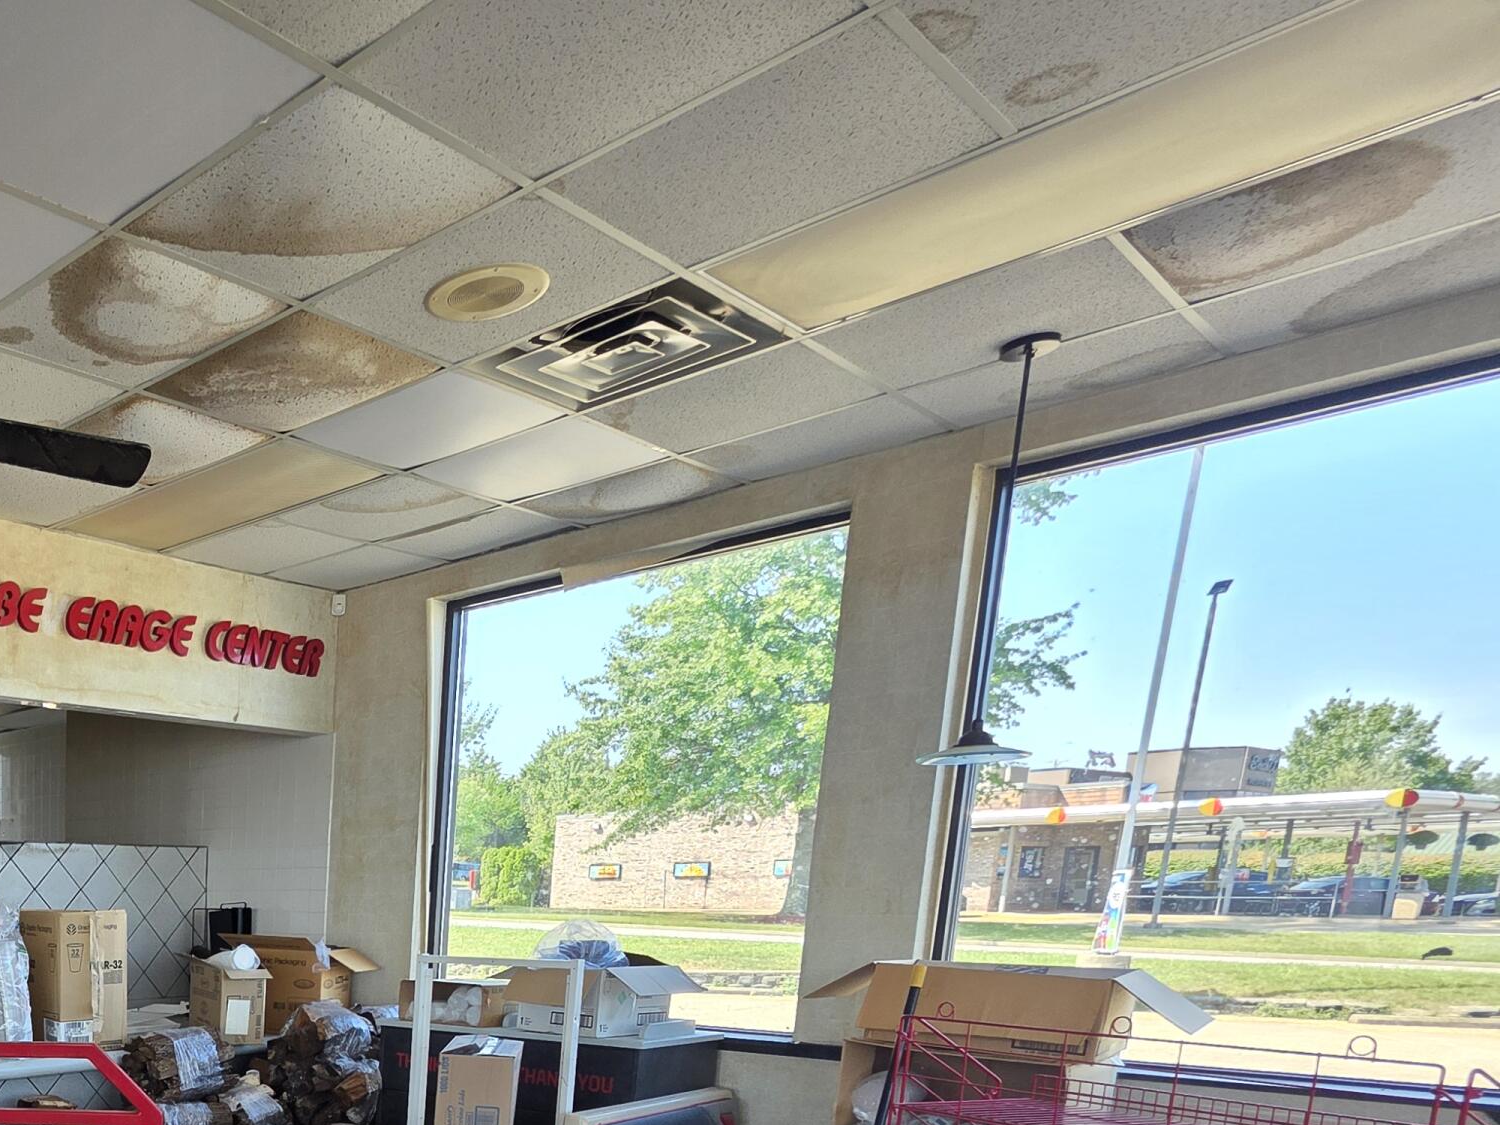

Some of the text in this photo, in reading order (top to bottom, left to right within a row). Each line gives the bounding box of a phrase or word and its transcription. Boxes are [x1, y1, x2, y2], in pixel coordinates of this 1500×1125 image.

[204, 620, 325, 677] CENTER
[71, 949, 80, 957] 32
[439, 1056, 450, 1093] 1000 LIDS
[579, 1075, 614, 1094] YOU
[458, 1089, 466, 1105] Lids
